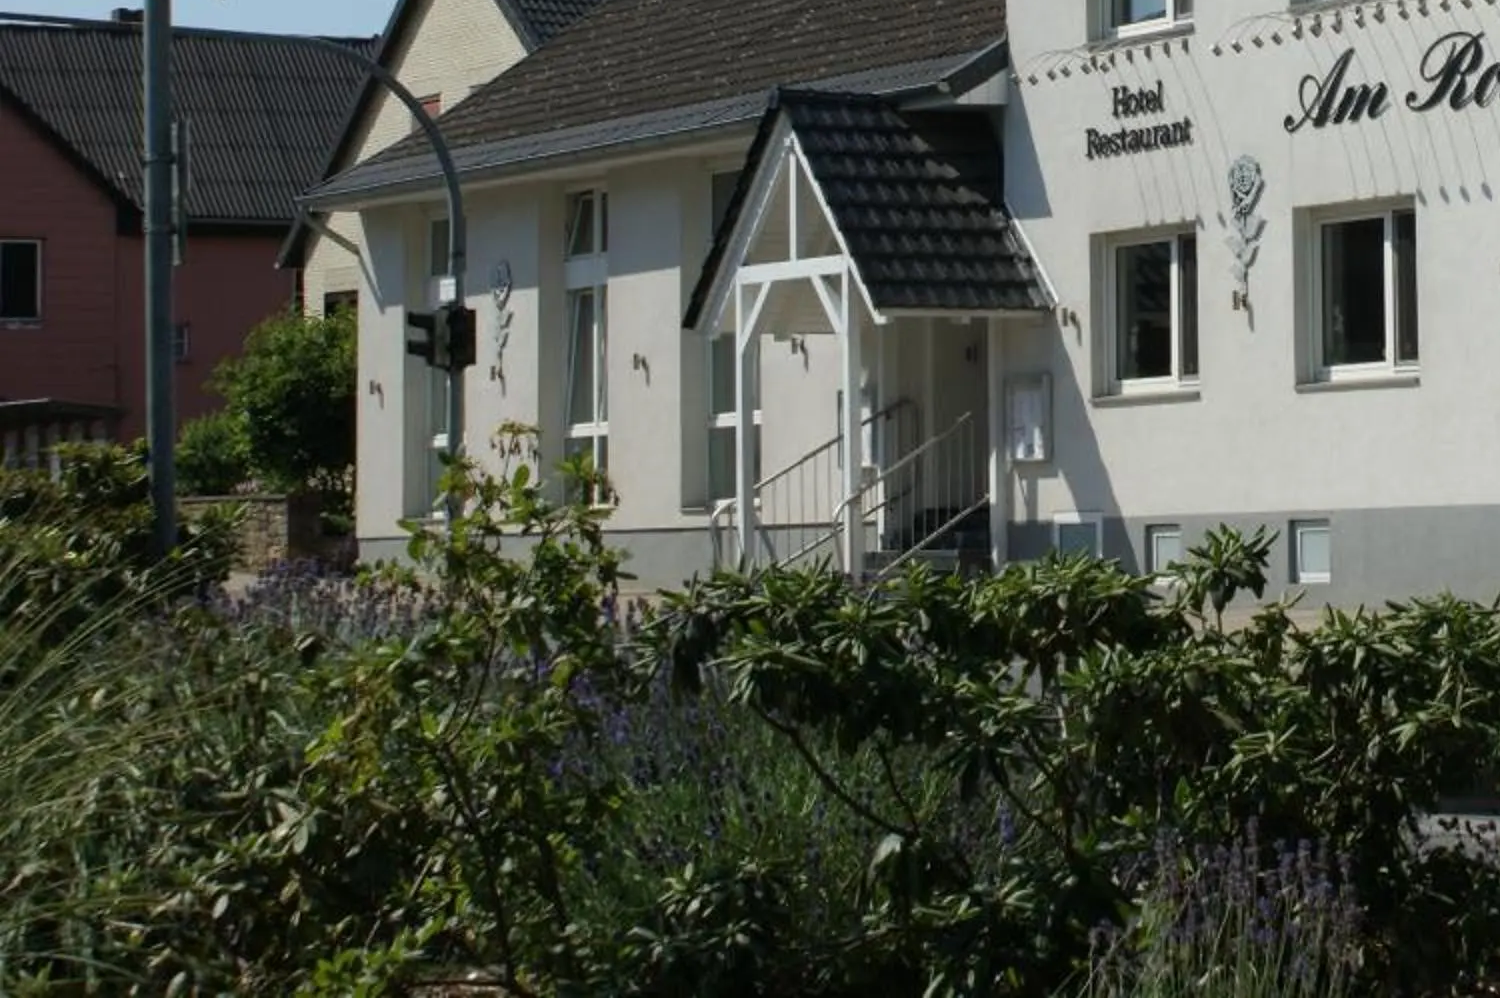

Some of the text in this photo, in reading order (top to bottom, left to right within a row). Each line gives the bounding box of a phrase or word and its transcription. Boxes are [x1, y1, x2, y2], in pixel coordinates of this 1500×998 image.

[1111, 79, 1165, 119] Hotel
[1284, 47, 1388, 133] Am
[1085, 115, 1194, 160] Restaurant
